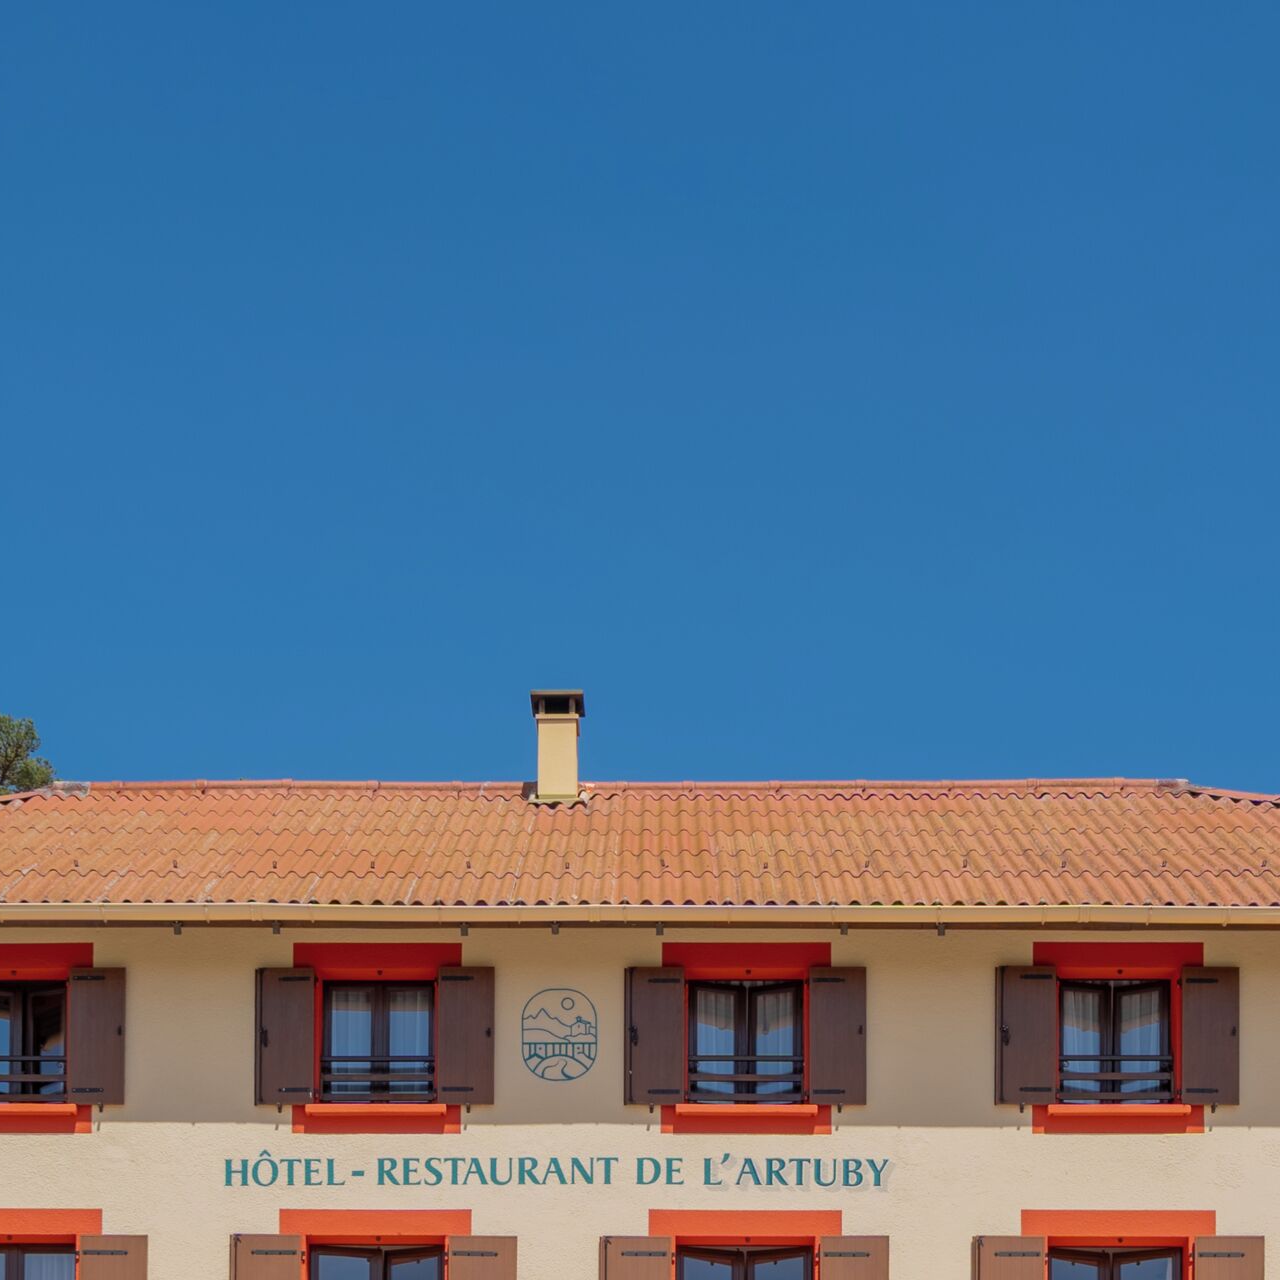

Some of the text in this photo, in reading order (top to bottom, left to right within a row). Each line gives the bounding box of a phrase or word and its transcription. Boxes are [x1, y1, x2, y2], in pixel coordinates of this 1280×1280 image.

[224, 1149, 346, 1187] HÔTEL
[377, 1157, 619, 1186] RESTAURANT
[636, 1157, 685, 1185] DE
[703, 1152, 890, 1187] L'ARTUBY
